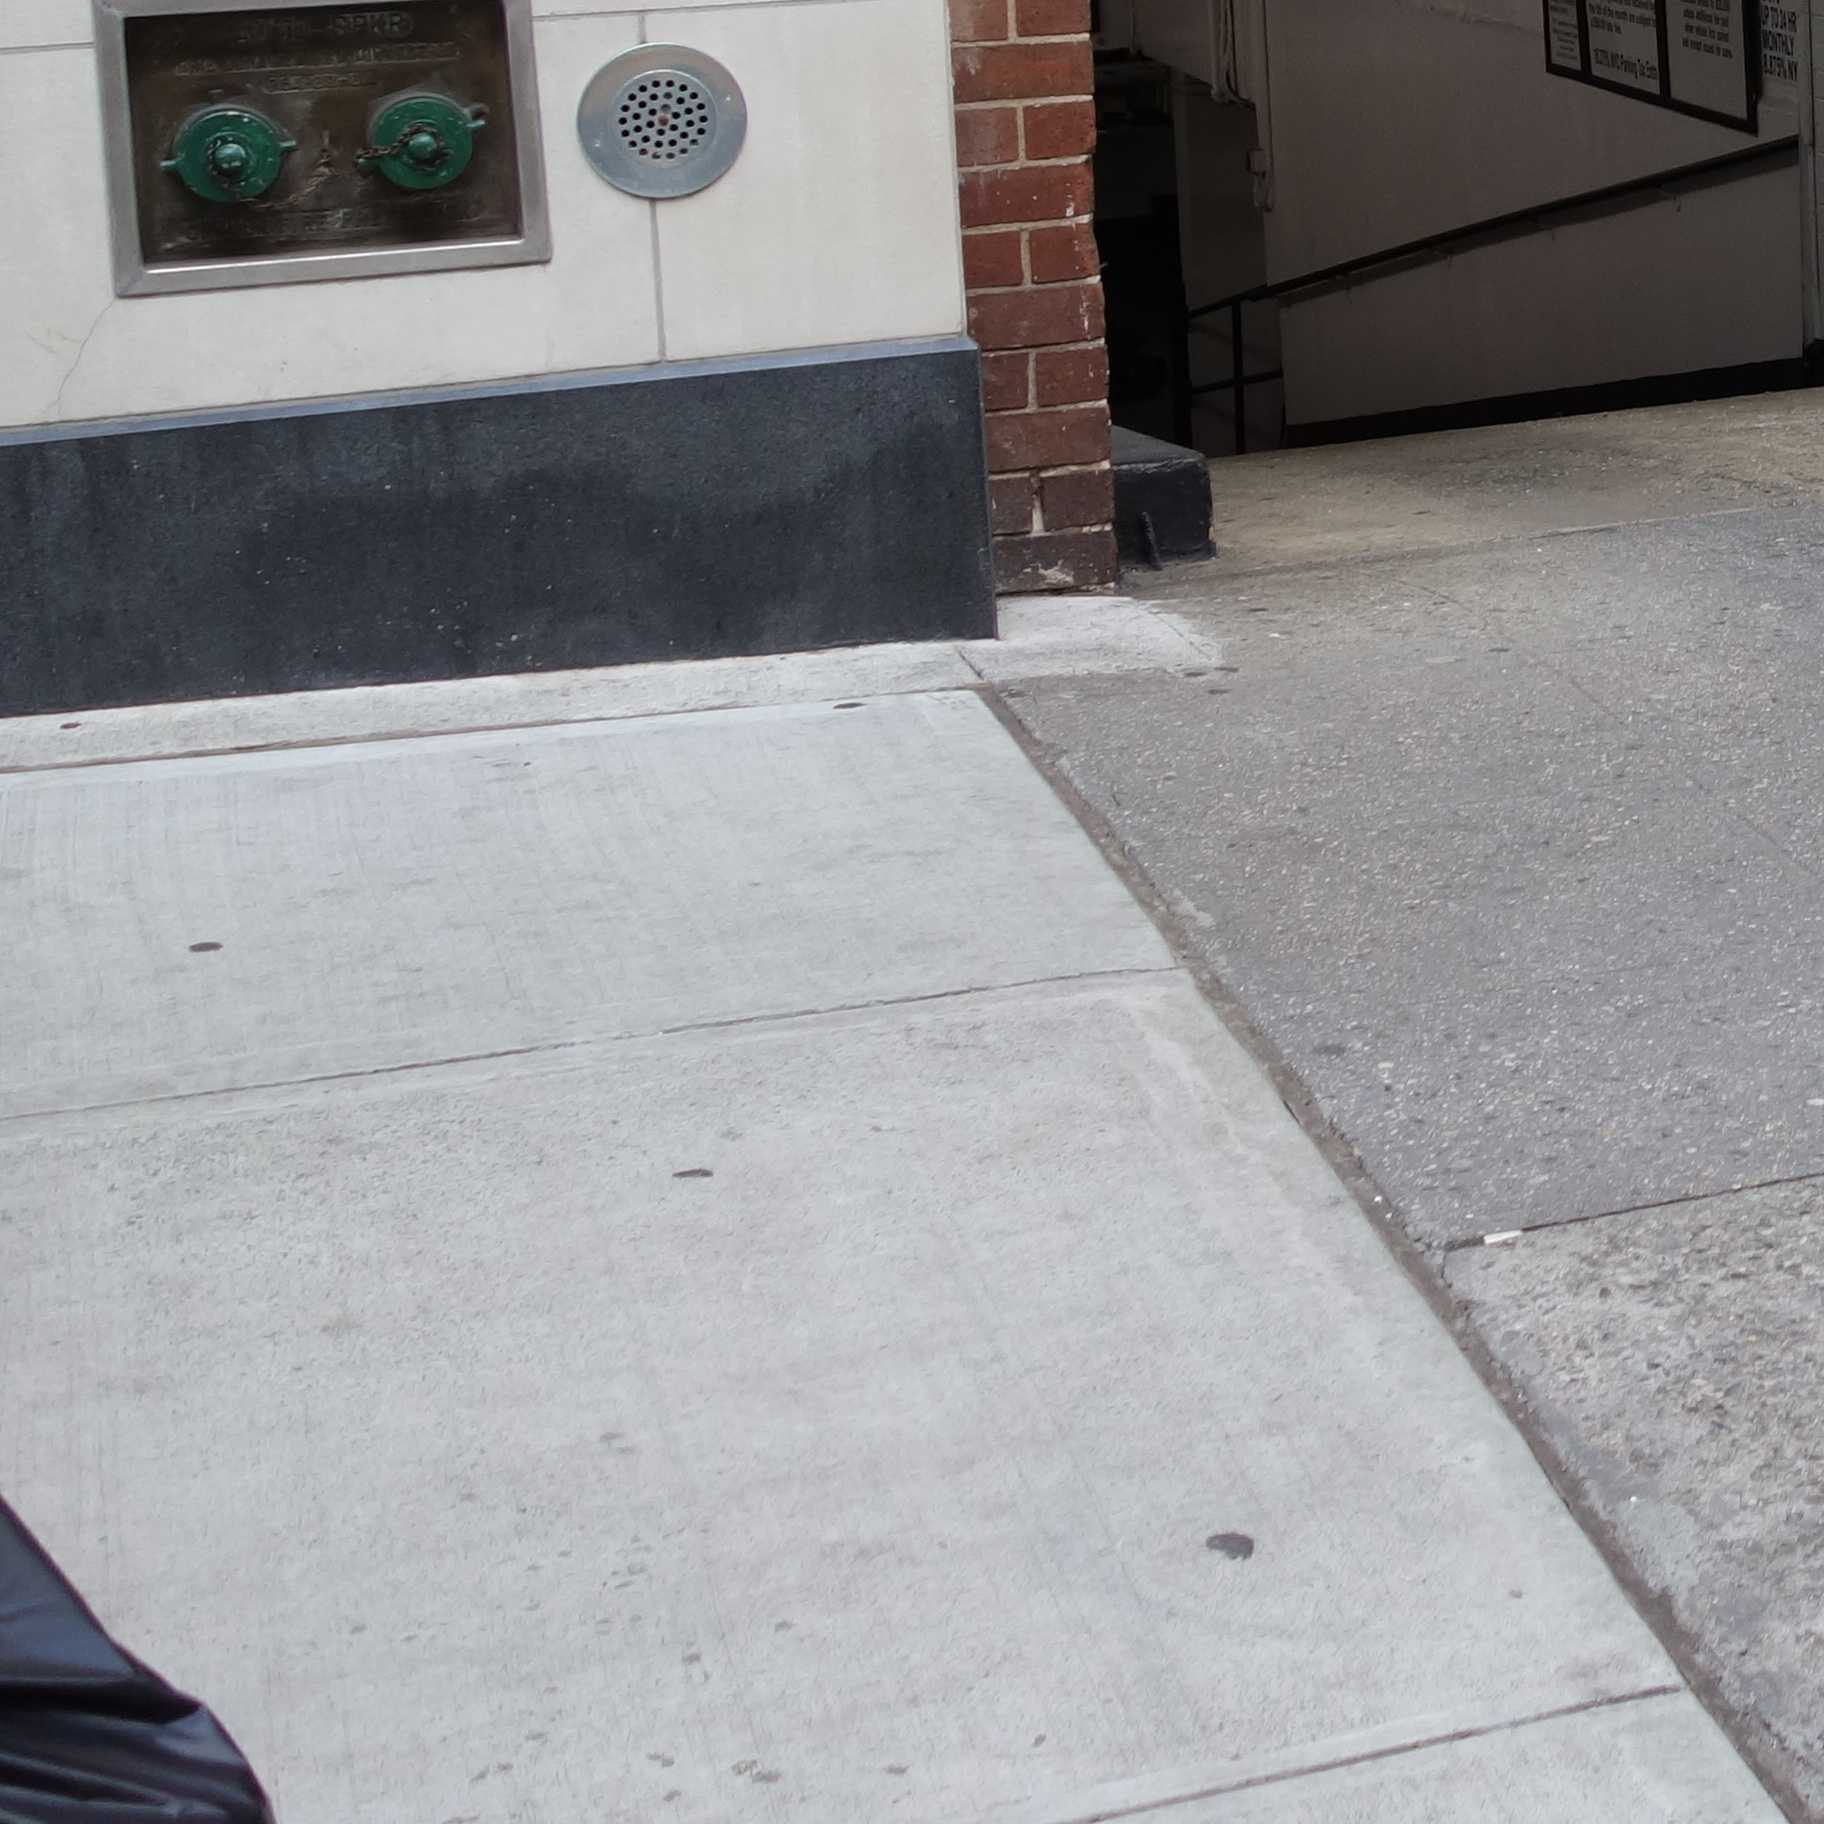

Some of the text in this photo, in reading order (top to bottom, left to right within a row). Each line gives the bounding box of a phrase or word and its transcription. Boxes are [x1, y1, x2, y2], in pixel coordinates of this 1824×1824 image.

[1770, 6, 1779, 29] TO
[1779, 7, 1786, 30] 24
[1761, 29, 1794, 56] MONTHLY
